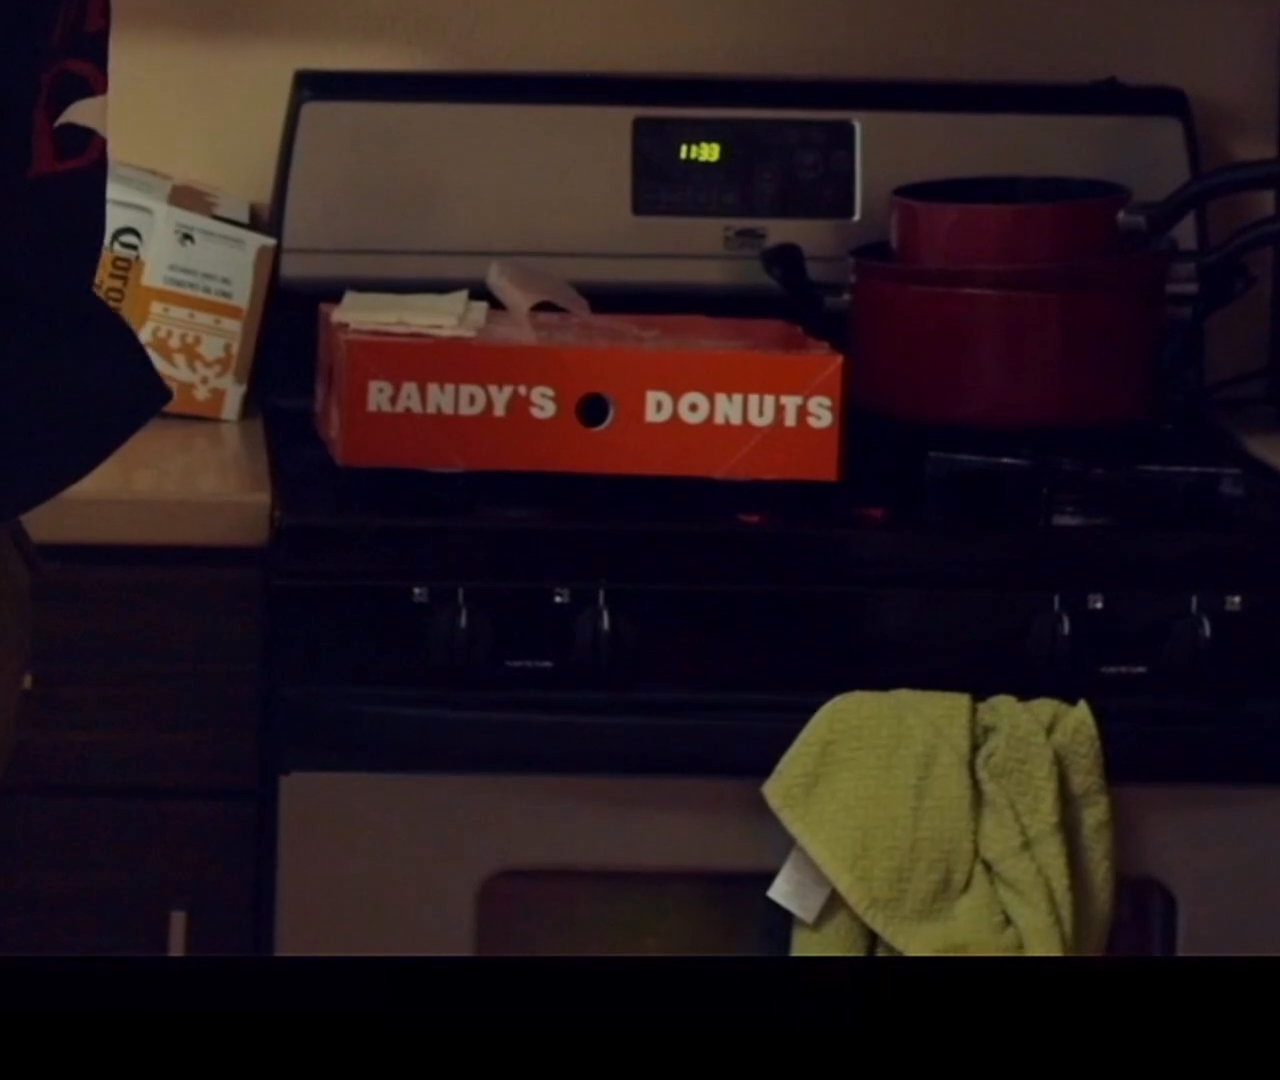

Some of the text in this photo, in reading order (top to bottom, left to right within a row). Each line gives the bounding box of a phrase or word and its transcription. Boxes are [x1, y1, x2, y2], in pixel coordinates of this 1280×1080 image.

[679, 141, 722, 163] 11:33
[106, 227, 143, 312] Coro
[366, 379, 835, 430] RANDY'S DONUTS
